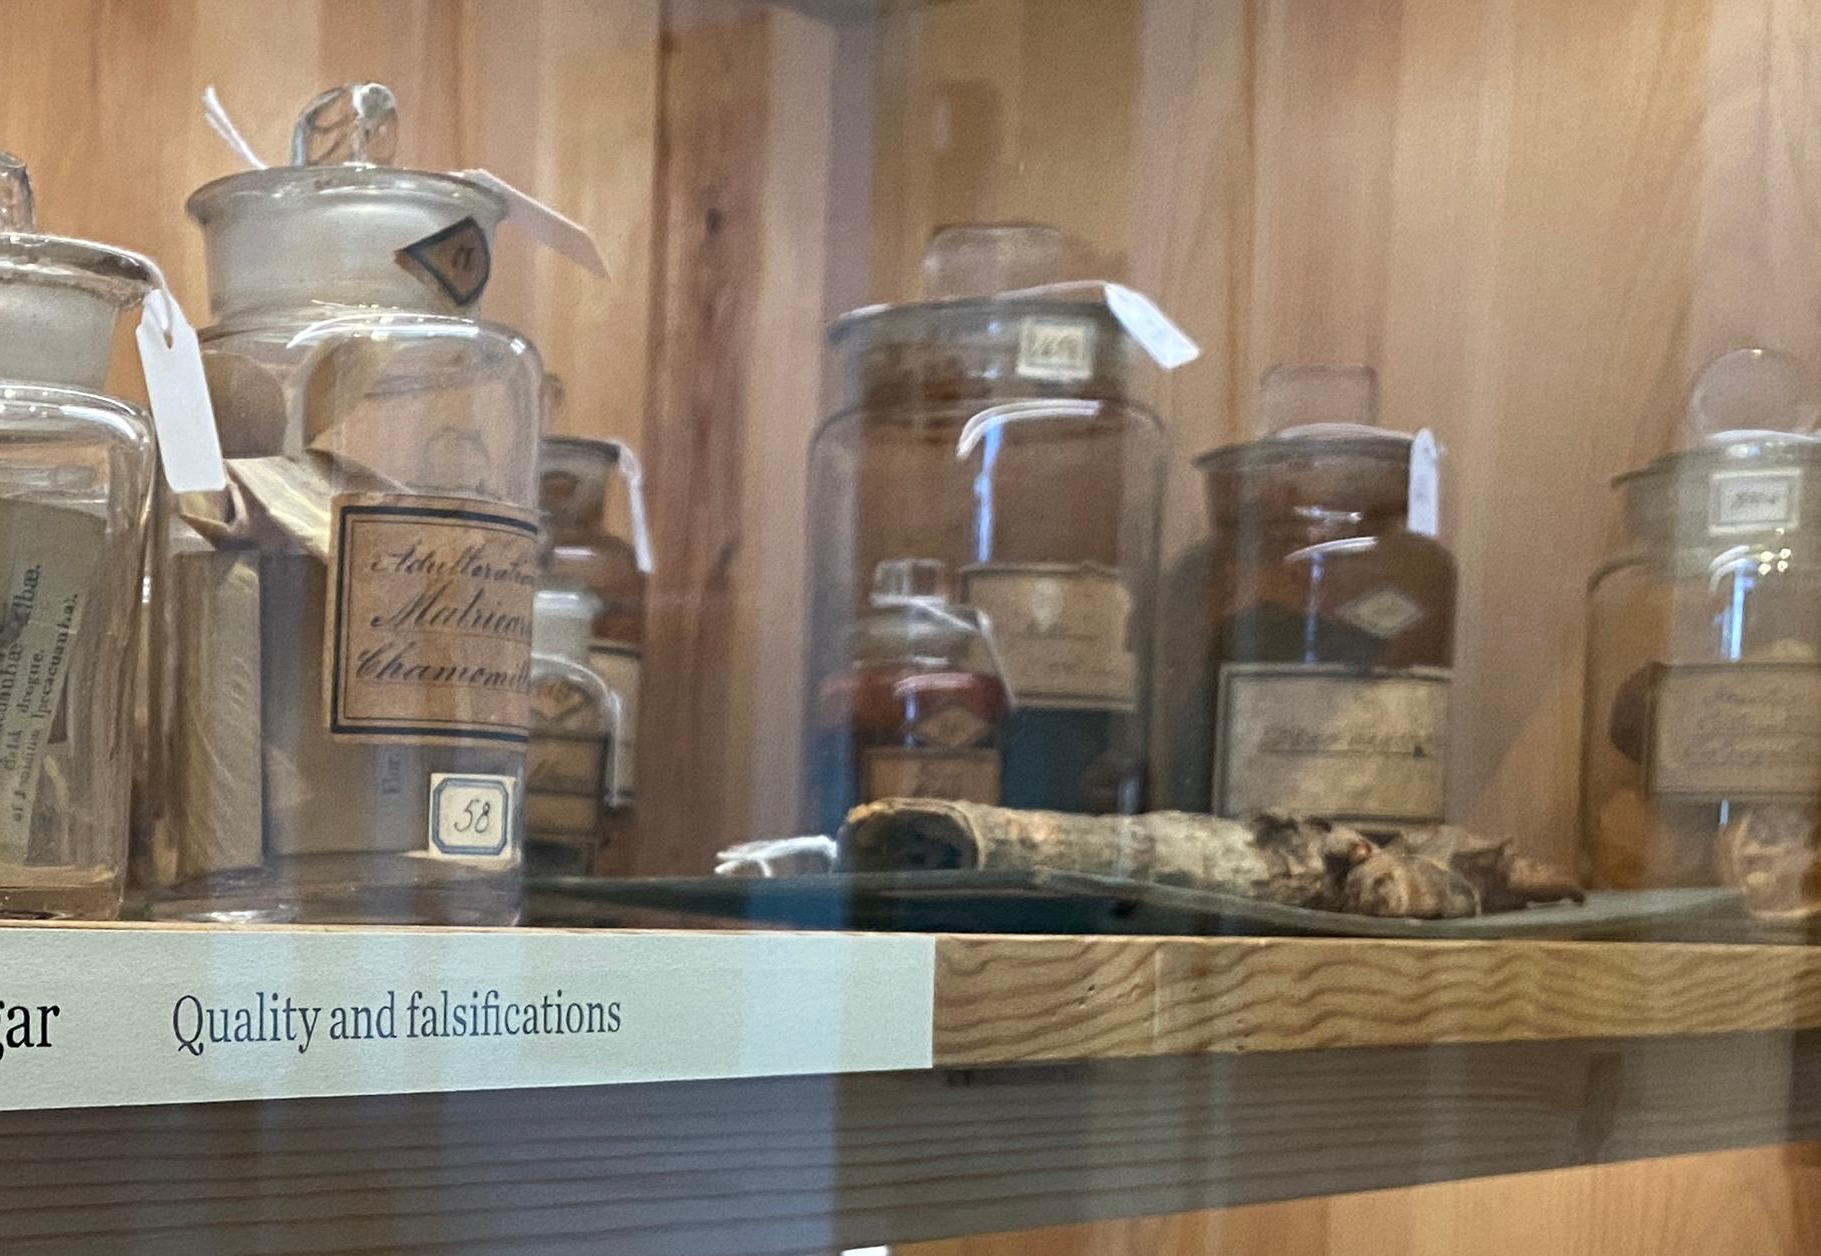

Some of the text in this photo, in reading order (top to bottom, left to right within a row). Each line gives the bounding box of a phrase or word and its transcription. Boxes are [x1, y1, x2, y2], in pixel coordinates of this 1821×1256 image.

[454, 798, 491, 834] 58
[173, 988, 622, 1056] Quality and falsifications
